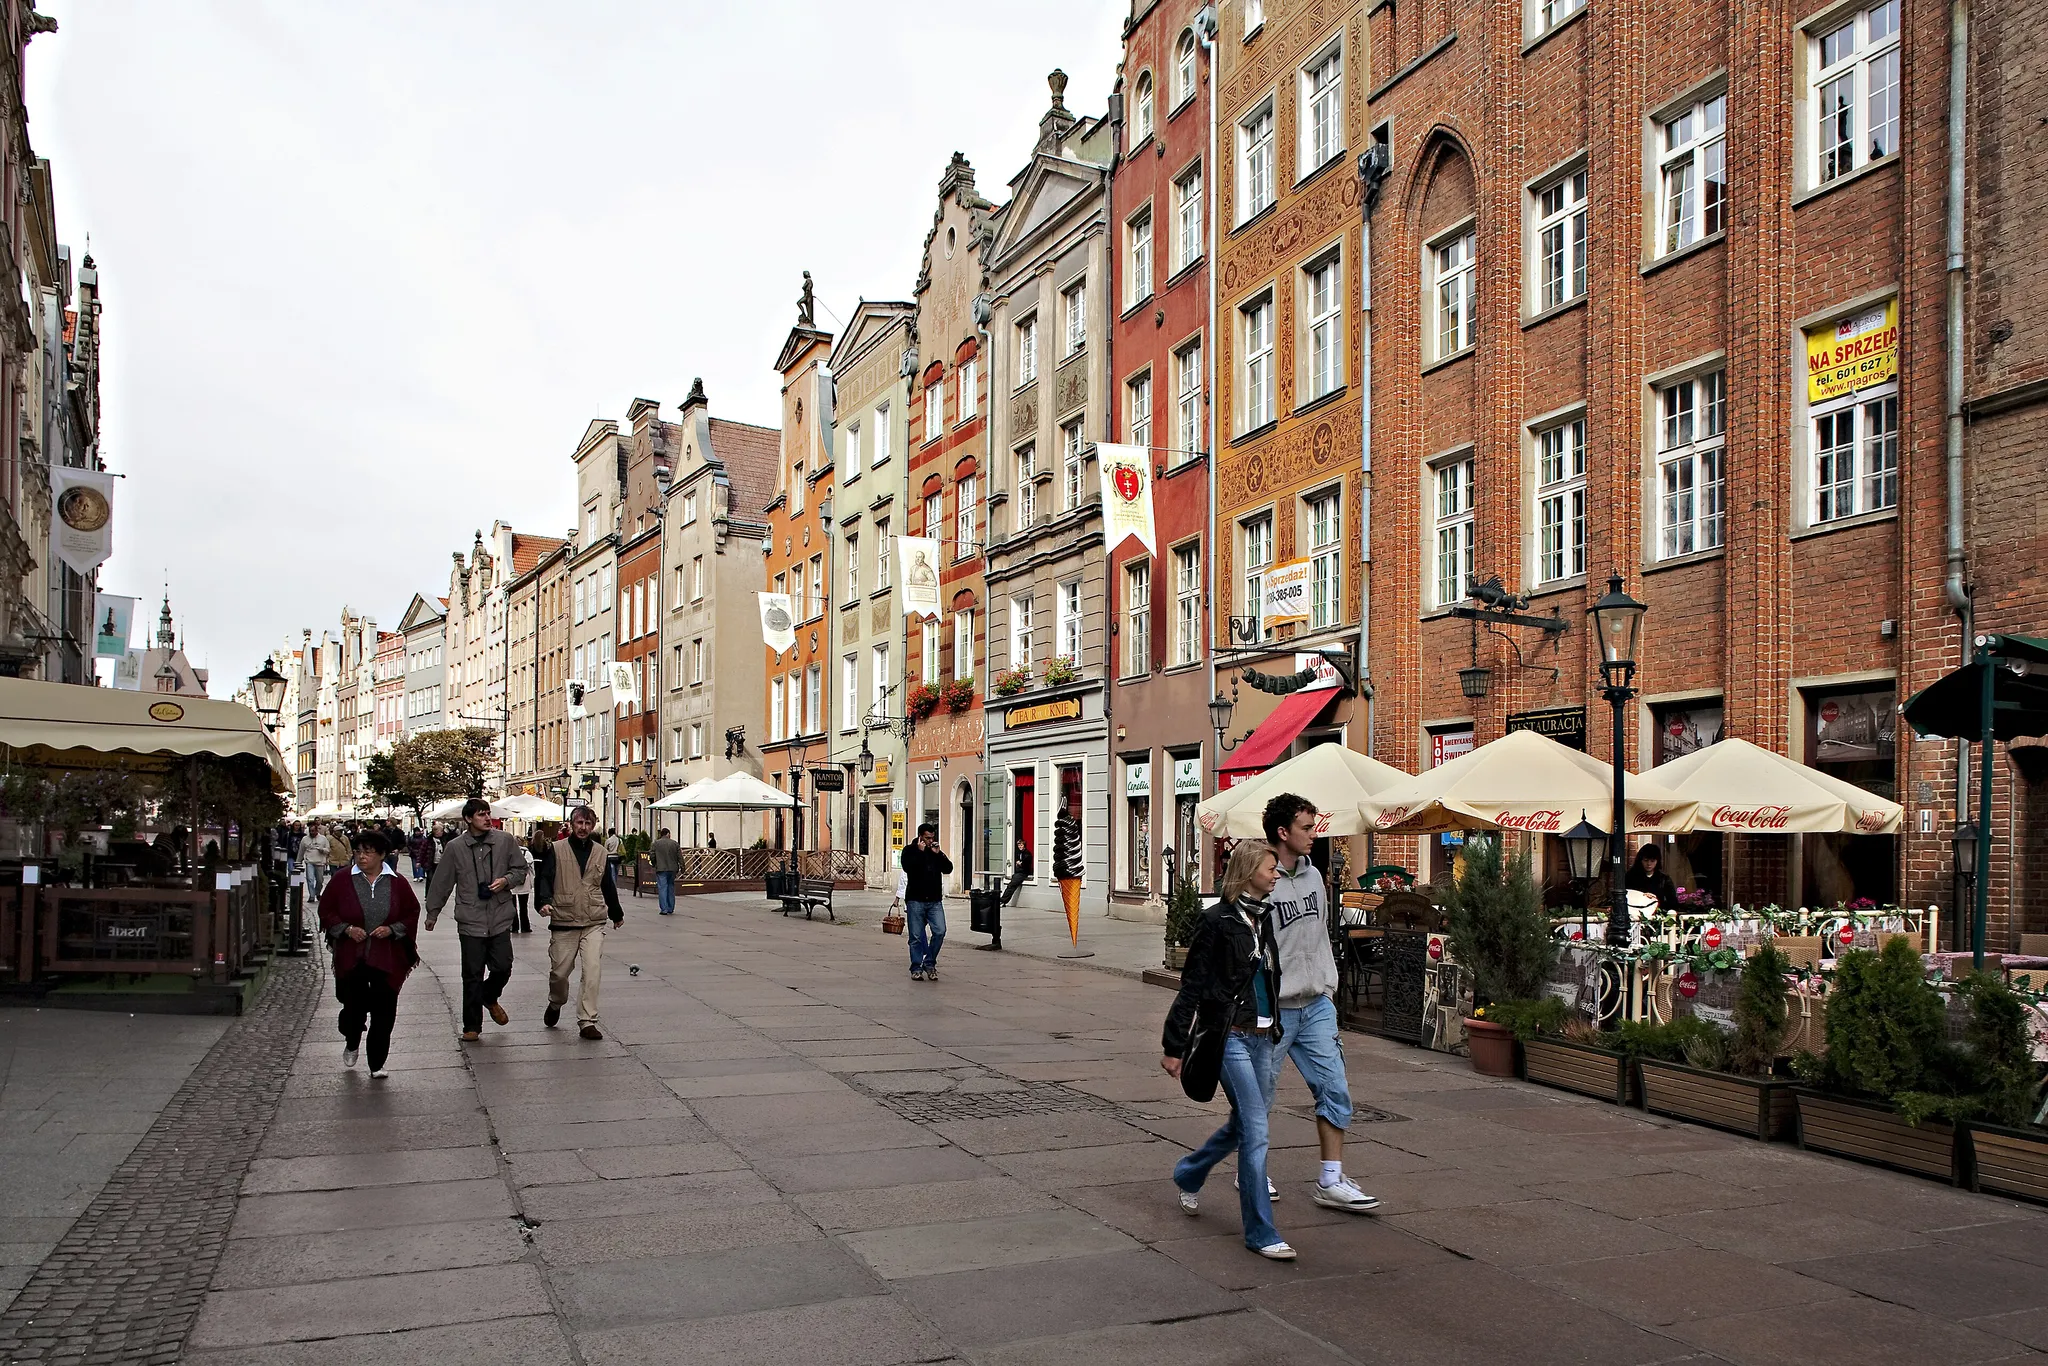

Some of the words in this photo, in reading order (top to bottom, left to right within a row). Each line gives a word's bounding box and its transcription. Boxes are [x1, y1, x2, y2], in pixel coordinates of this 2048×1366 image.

[1838, 312, 1882, 336] MAGROS
[1809, 350, 1830, 371] NA
[1816, 374, 1833, 386] tel.
[1837, 366, 1856, 380] 601
[1860, 357, 1882, 372] 627
[1045, 703, 1069, 718] KNIE
[1510, 717, 1583, 733] RESTAURACJA
[816, 773, 843, 781] KANTOR
[1127, 780, 1149, 791] Cepelia
[1175, 777, 1200, 791] Cepelia
[1495, 810, 1564, 831] Coca-Cola
[1711, 804, 1793, 829] Coca-Cola
